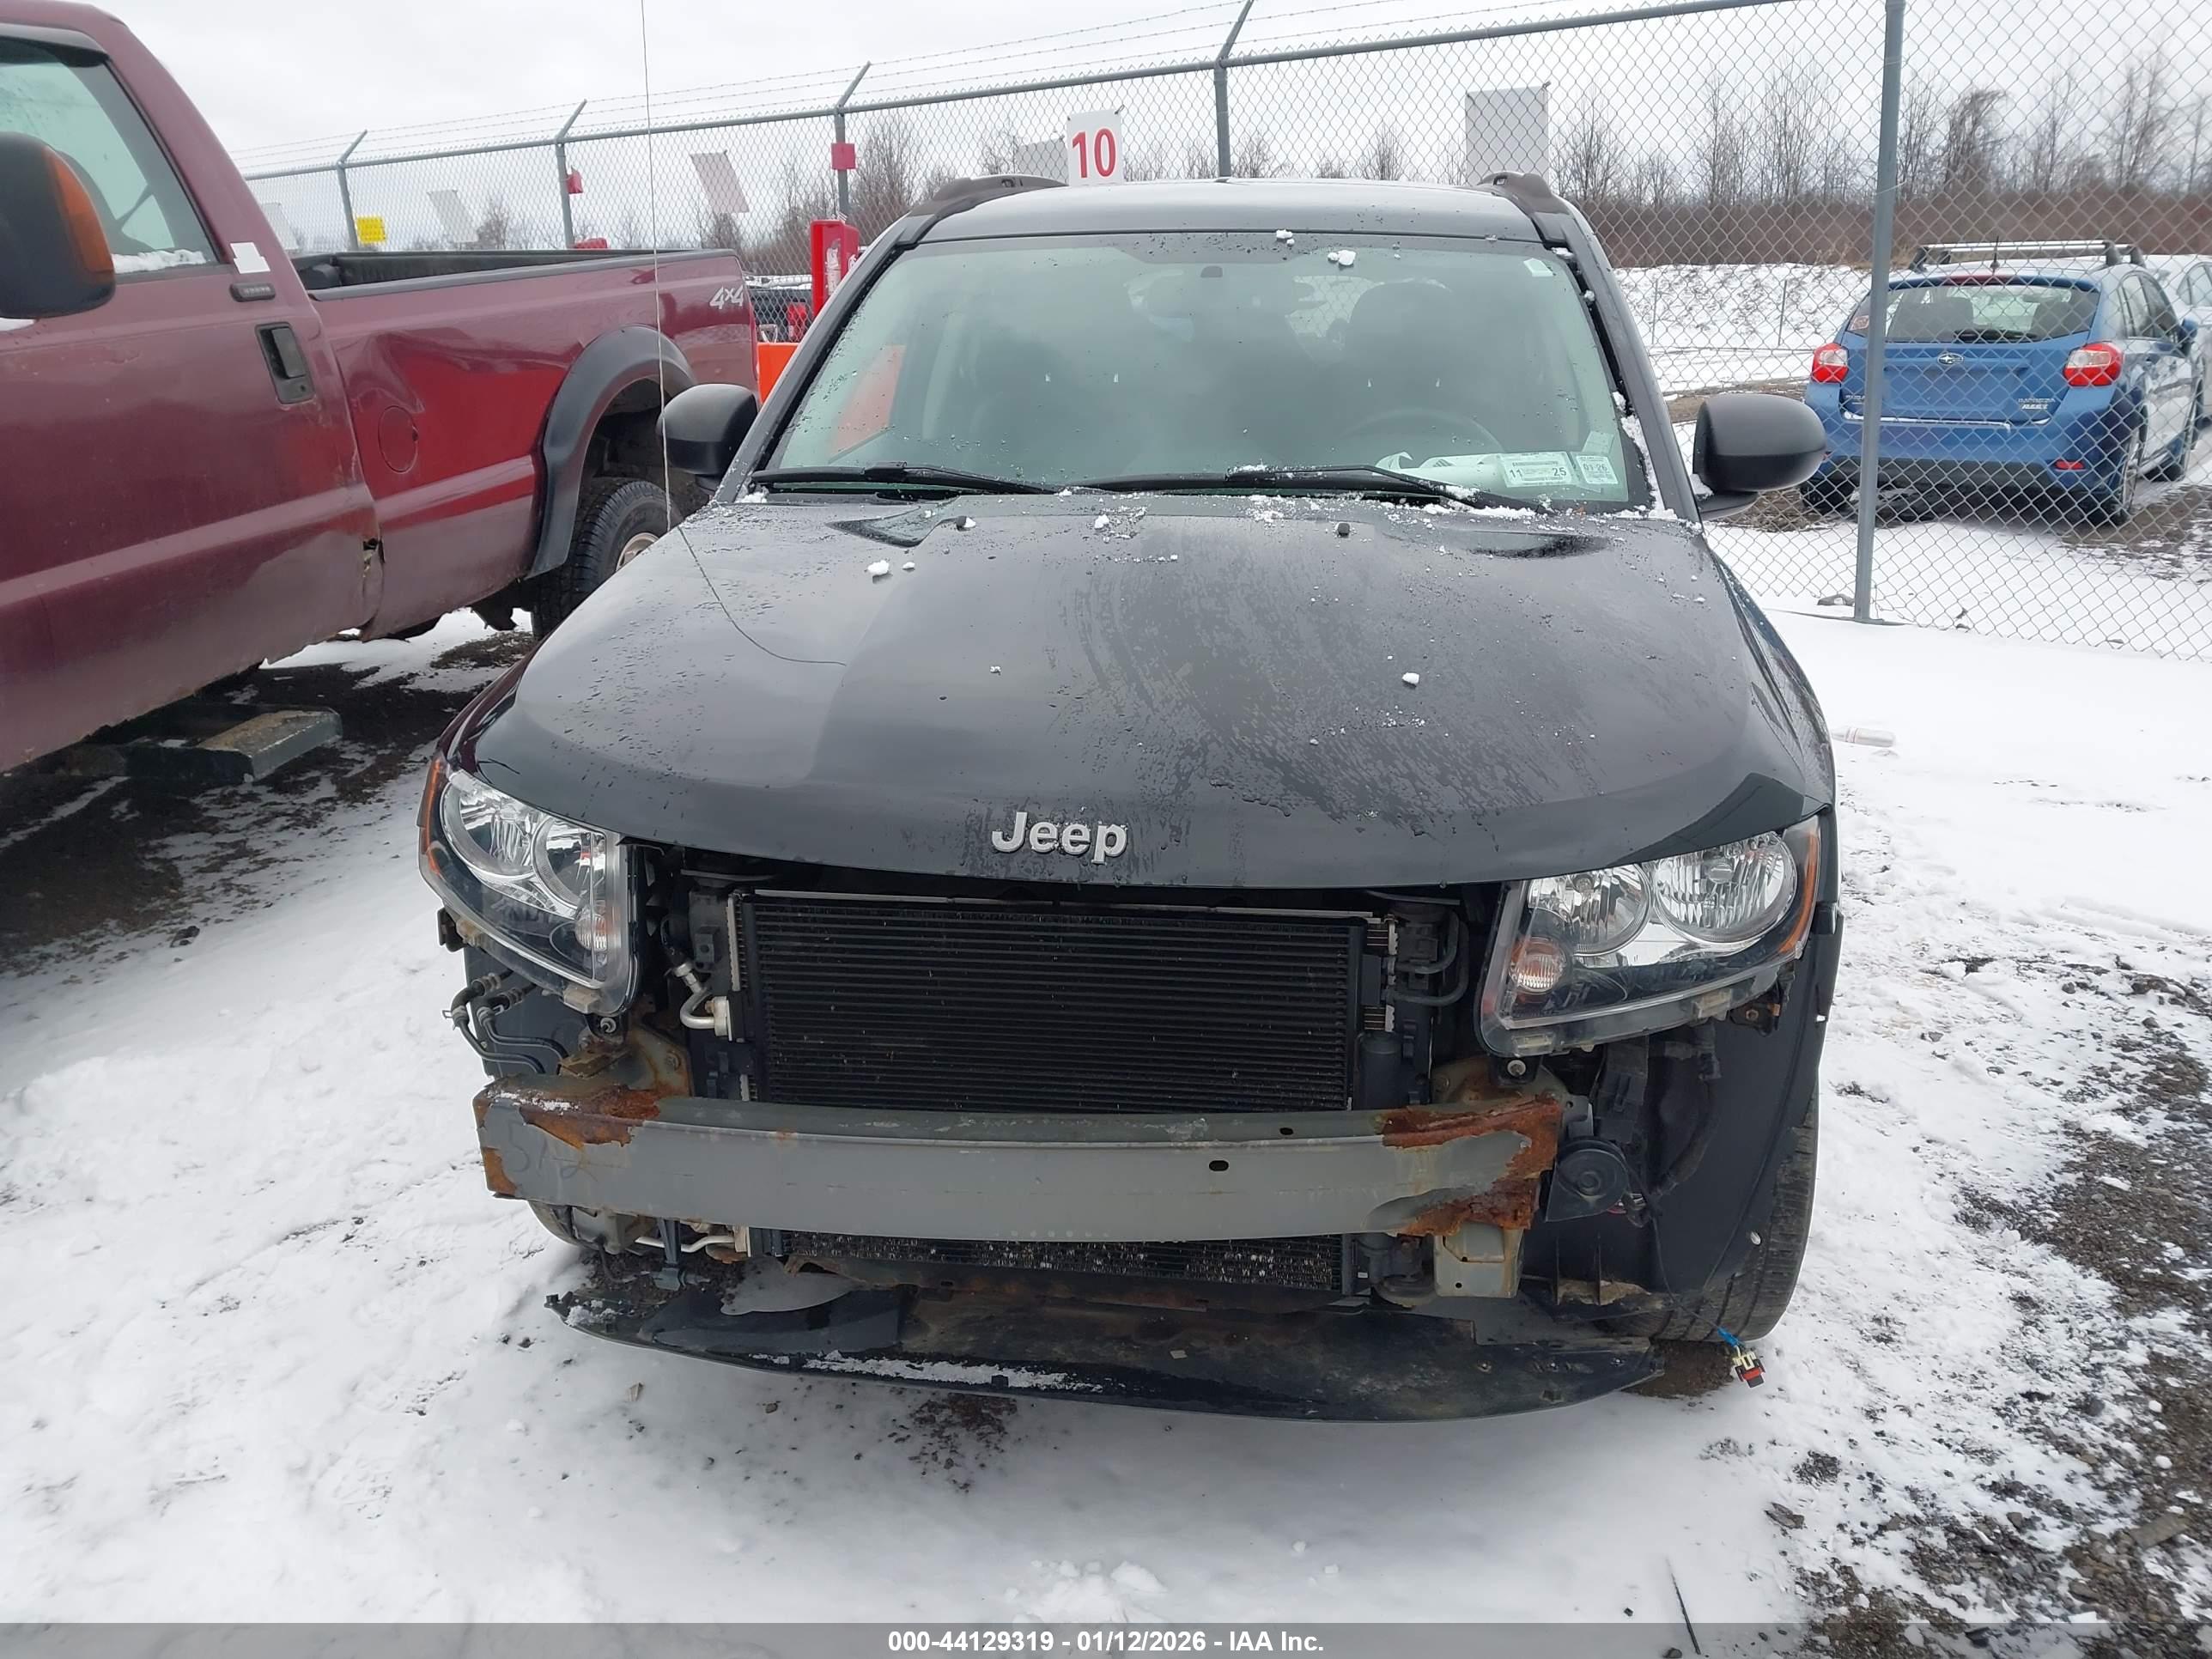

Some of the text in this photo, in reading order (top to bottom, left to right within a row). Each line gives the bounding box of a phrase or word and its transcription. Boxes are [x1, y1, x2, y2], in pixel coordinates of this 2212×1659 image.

[1072, 128, 1116, 179] 10
[1552, 467, 1566, 477] 25
[992, 811, 1127, 865] Jeep
